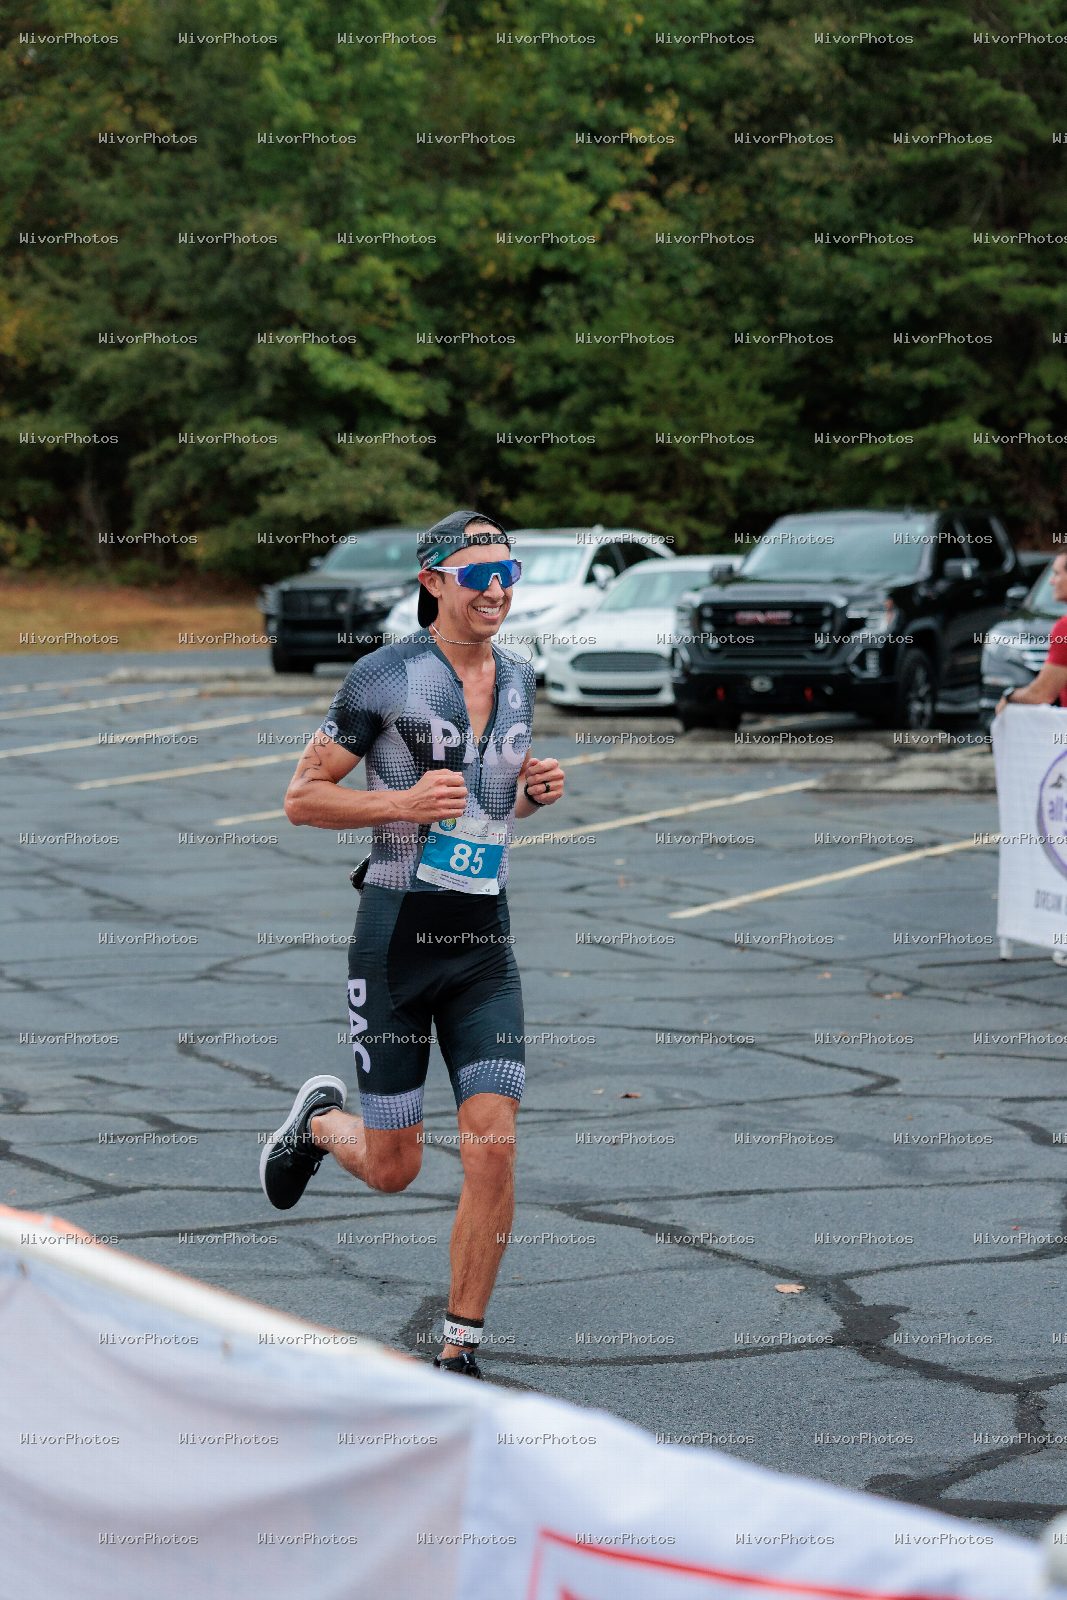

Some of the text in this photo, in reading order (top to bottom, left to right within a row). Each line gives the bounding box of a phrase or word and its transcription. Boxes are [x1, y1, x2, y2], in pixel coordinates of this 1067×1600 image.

[430, 719, 527, 766] PAC
[449, 843, 486, 875] 85
[347, 978, 371, 1074] PAC
